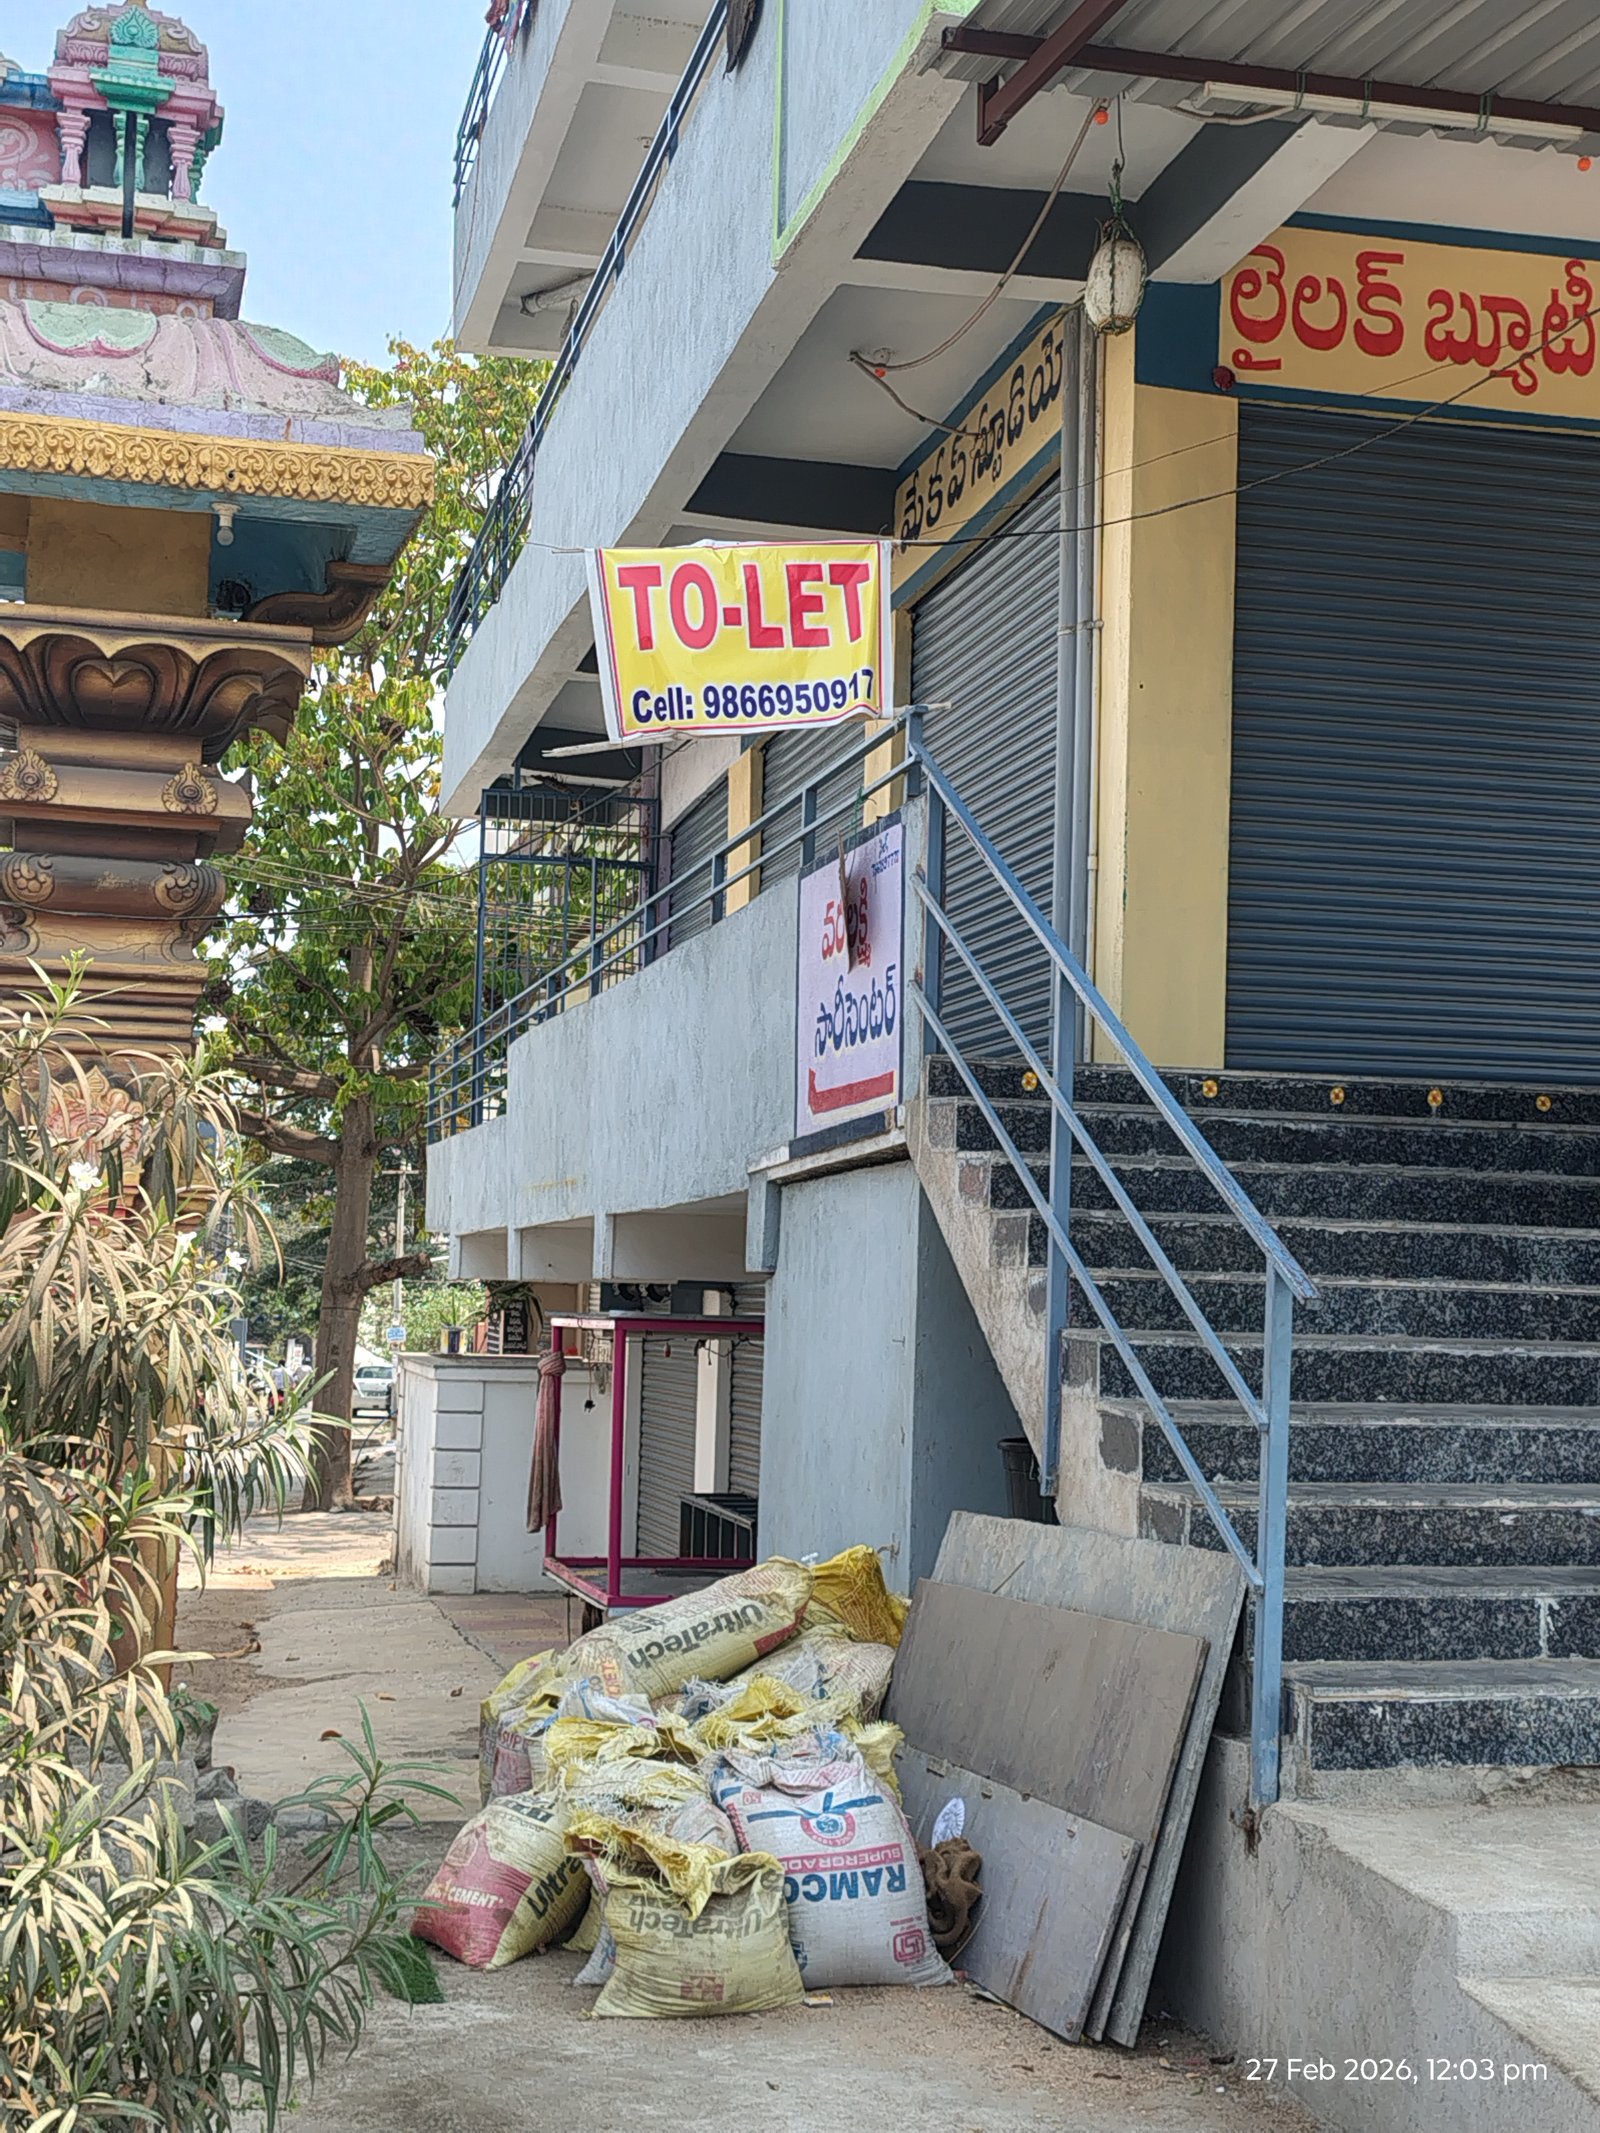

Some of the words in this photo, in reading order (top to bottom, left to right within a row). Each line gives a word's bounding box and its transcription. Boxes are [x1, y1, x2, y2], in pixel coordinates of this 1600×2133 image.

[617, 562, 870, 651] TO-LET
[632, 686, 693, 723] Cell:
[703, 669, 874, 719] 9866950917
[628, 1604, 763, 1669] UltraTech
[527, 1856, 583, 1920] Ultra
[630, 1905, 762, 1939] UltraTech
